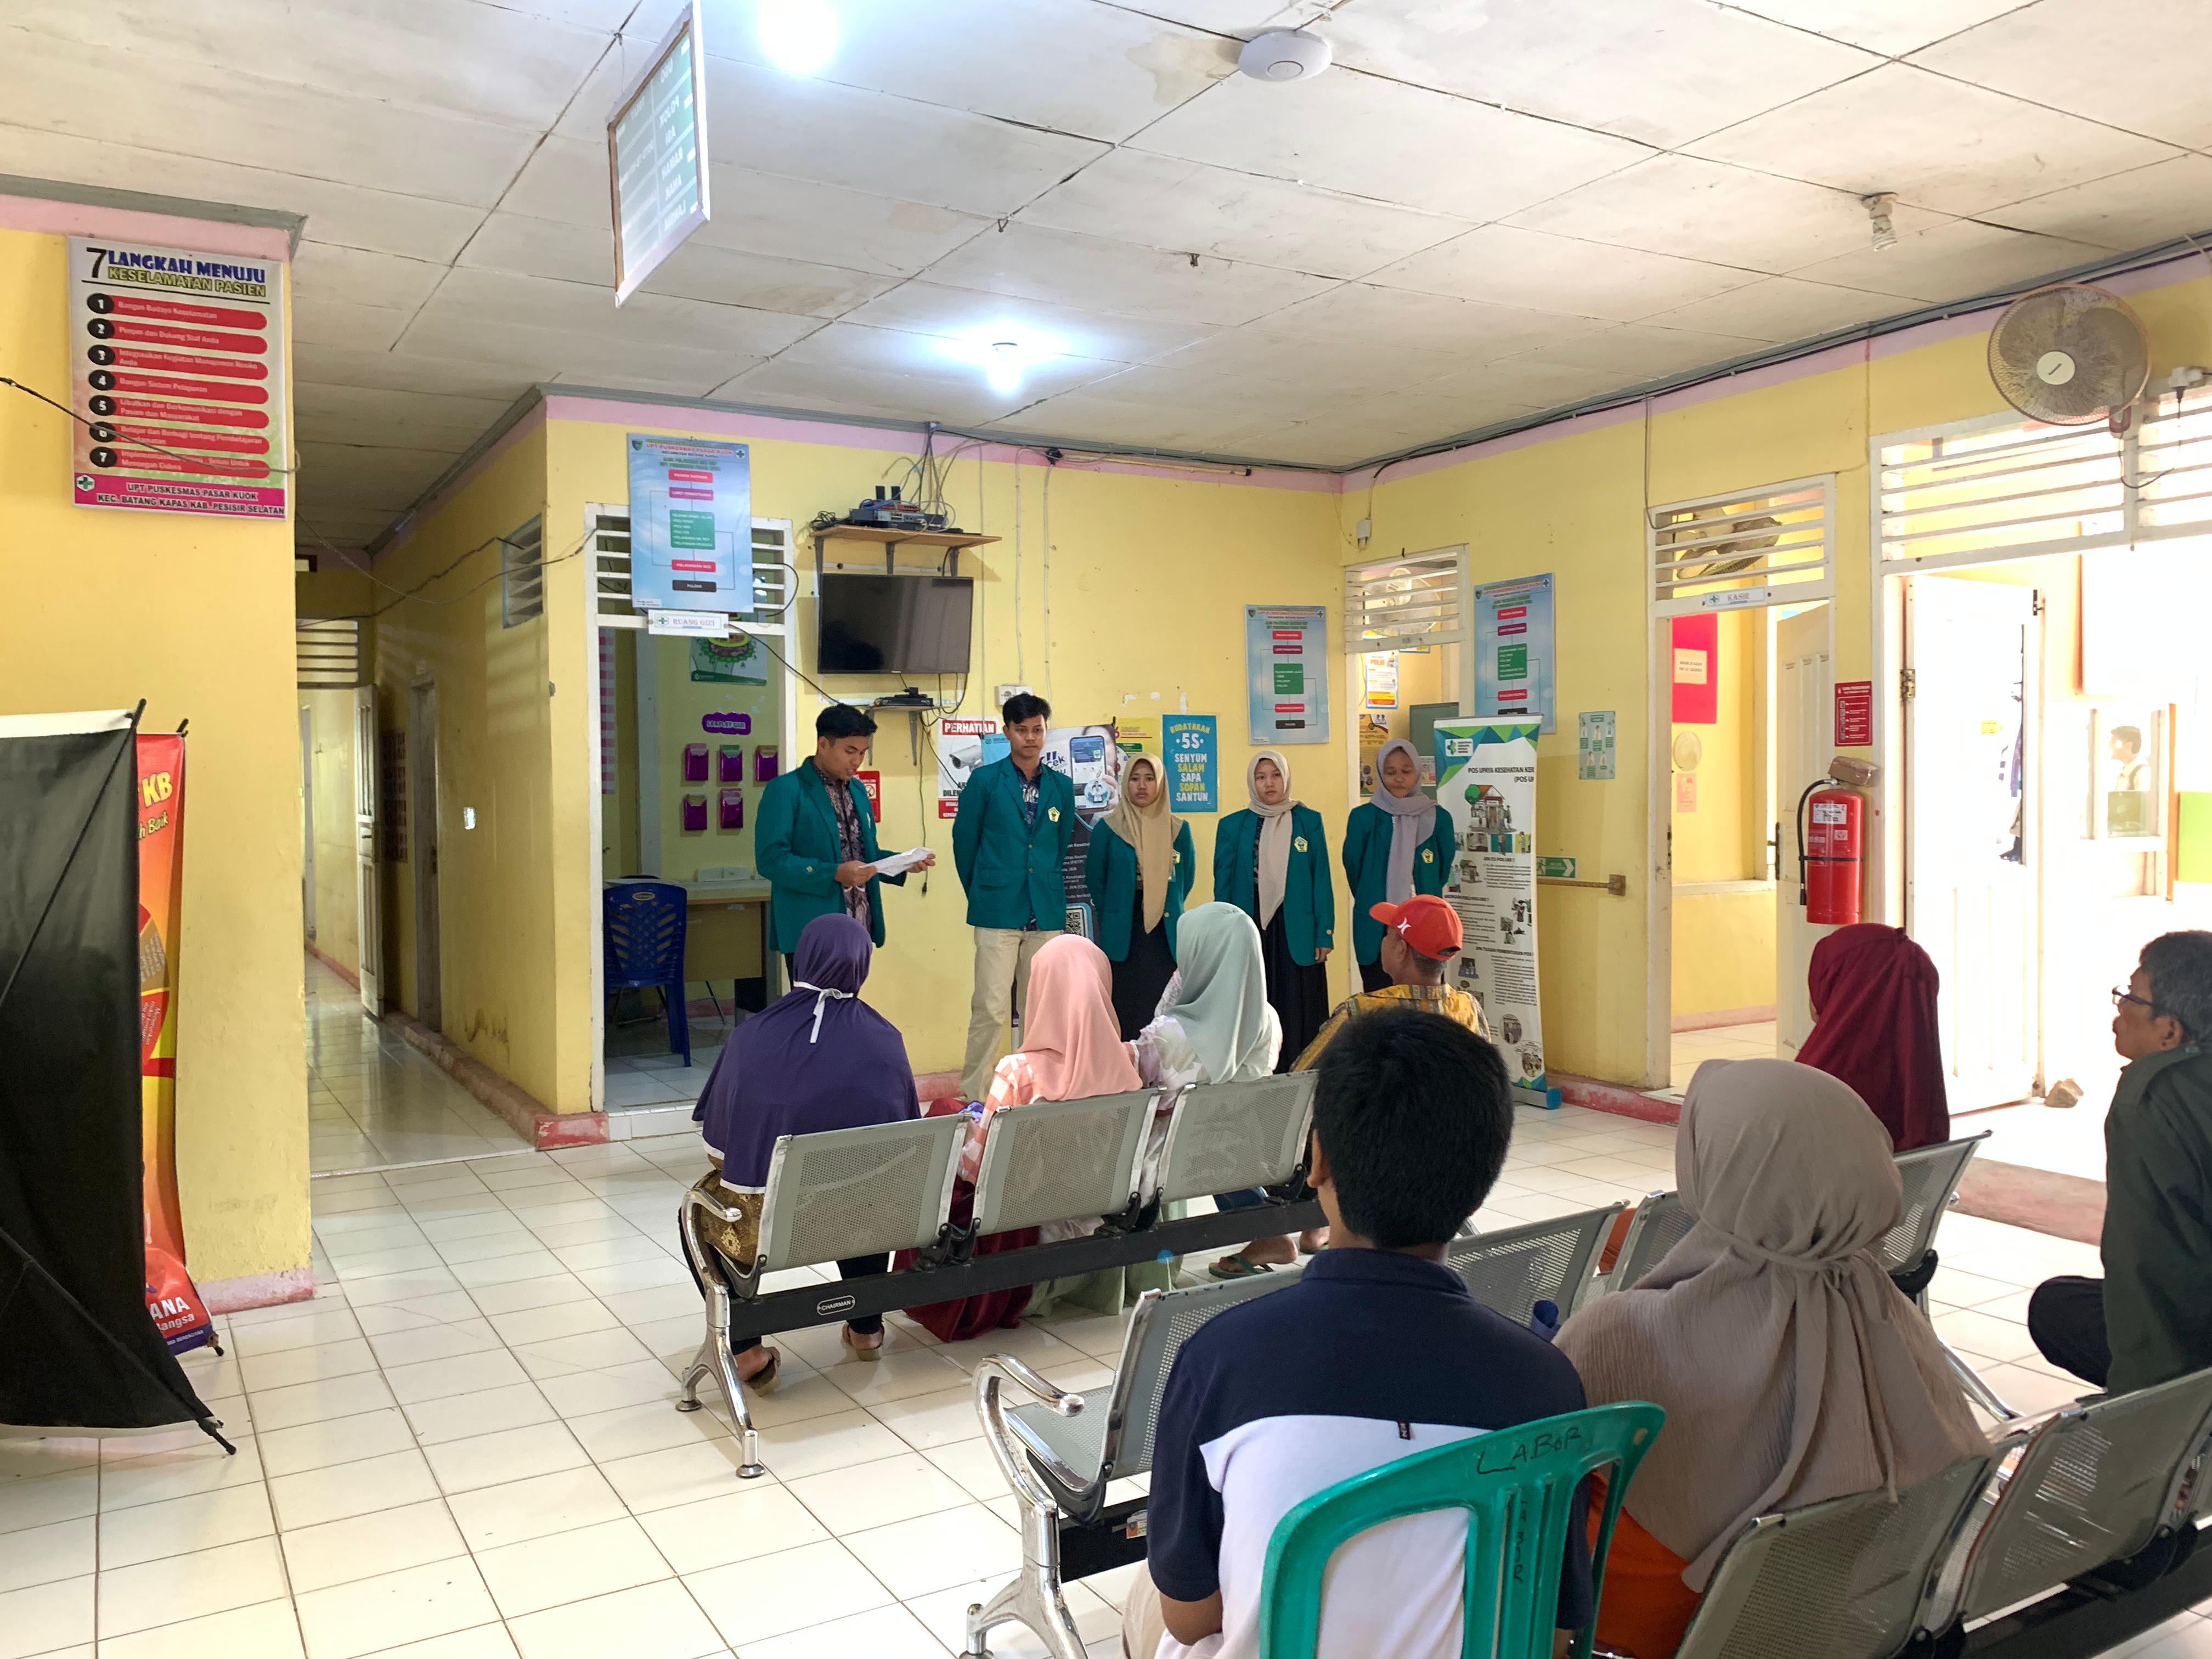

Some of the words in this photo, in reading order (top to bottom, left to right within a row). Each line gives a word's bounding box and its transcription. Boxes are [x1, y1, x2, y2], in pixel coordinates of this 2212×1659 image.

[87, 247, 107, 278] 7
[108, 250, 192, 274] LANGKAH
[196, 261, 265, 283] MENUJU
[108, 266, 213, 291] KESELAMATAN
[215, 279, 266, 297] PASIEN
[98, 299, 104, 309] 1
[97, 323, 105, 334] 2
[98, 349, 105, 360] 3
[98, 375, 106, 386] 4
[99, 400, 107, 411] 5
[99, 452, 107, 463] 7
[148, 485, 200, 496] PUSKESMAS
[203, 489, 230, 498] PASAR
[233, 492, 257, 500] KUOK
[98, 494, 119, 503] KEC.
[121, 495, 156, 506] BATANG
[160, 499, 187, 508] KAPAS
[190, 501, 211, 510] KAB.
[213, 503, 245, 511] PESISIR
[248, 505, 285, 515] SELATAN
[1728, 593, 1750, 601] KASIR
[944, 723, 995, 733] PERHATIAN
[1175, 753, 1207, 763] SENYUM
[1178, 763, 1205, 772] SALAM
[1181, 773, 1201, 782] SAPA
[142, 771, 173, 808] KB
[1180, 782, 1205, 792] SOPAN
[1176, 792, 1208, 802] SANTUN
[821, 1300, 851, 1311] CHAIRMAN
